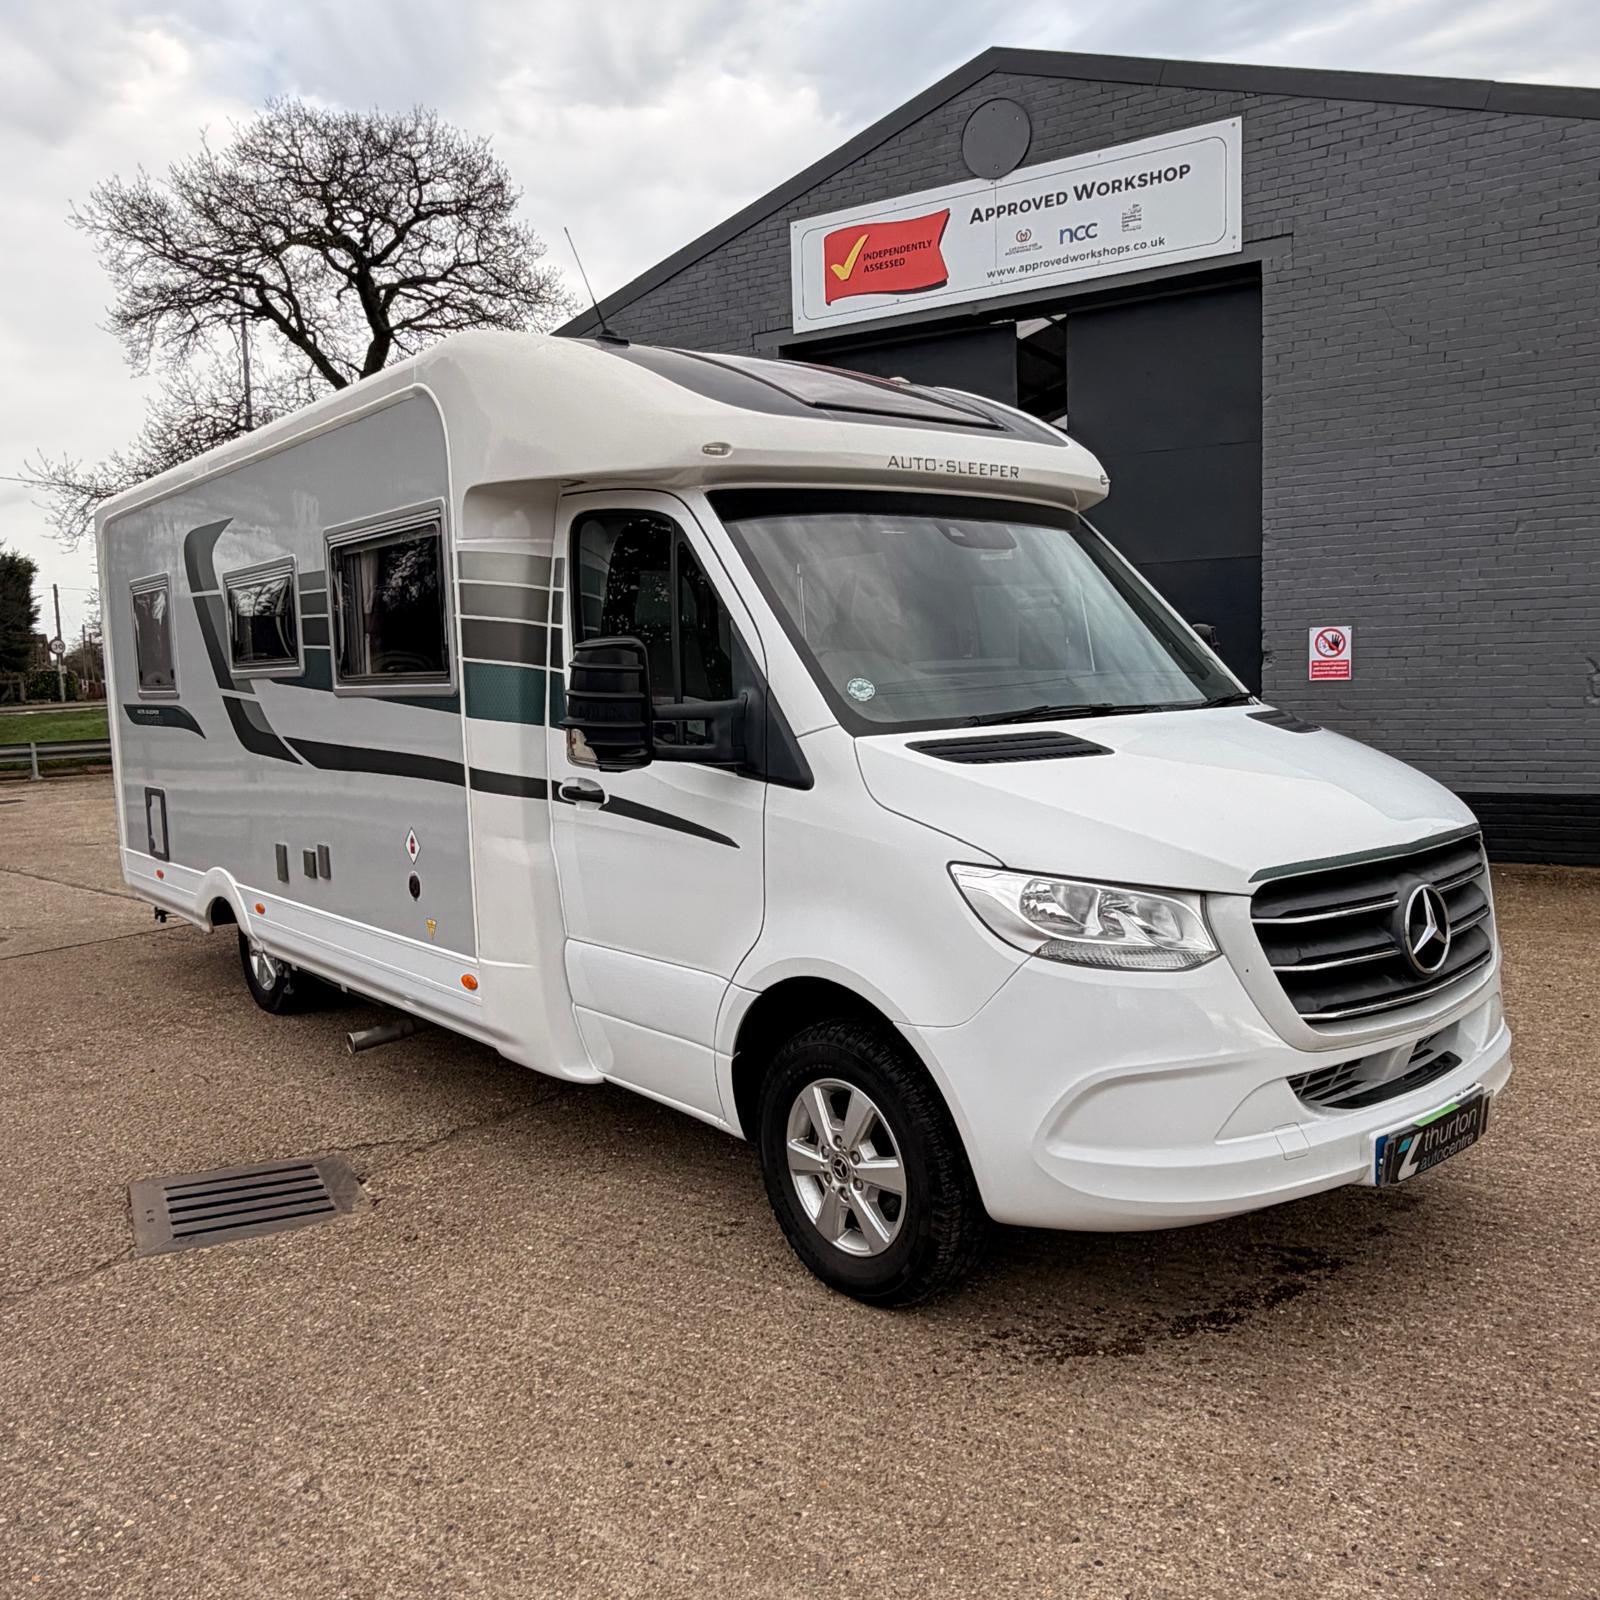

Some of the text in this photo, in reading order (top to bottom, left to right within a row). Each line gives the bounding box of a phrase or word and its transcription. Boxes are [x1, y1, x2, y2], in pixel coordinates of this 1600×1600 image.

[969, 164, 1191, 225] APPROVED WORKSHOP
[1059, 222, 1098, 245] ncc
[863, 240, 932, 261] INDEPENDENTLY
[864, 258, 905, 273] ASSESSED
[986, 237, 1165, 279] www.approvedworkshops.co.uk
[887, 455, 1019, 478] AUTO-SLEEPER
[1425, 1108, 1476, 1151] thurton
[1421, 1132, 1474, 1169] autocentre
